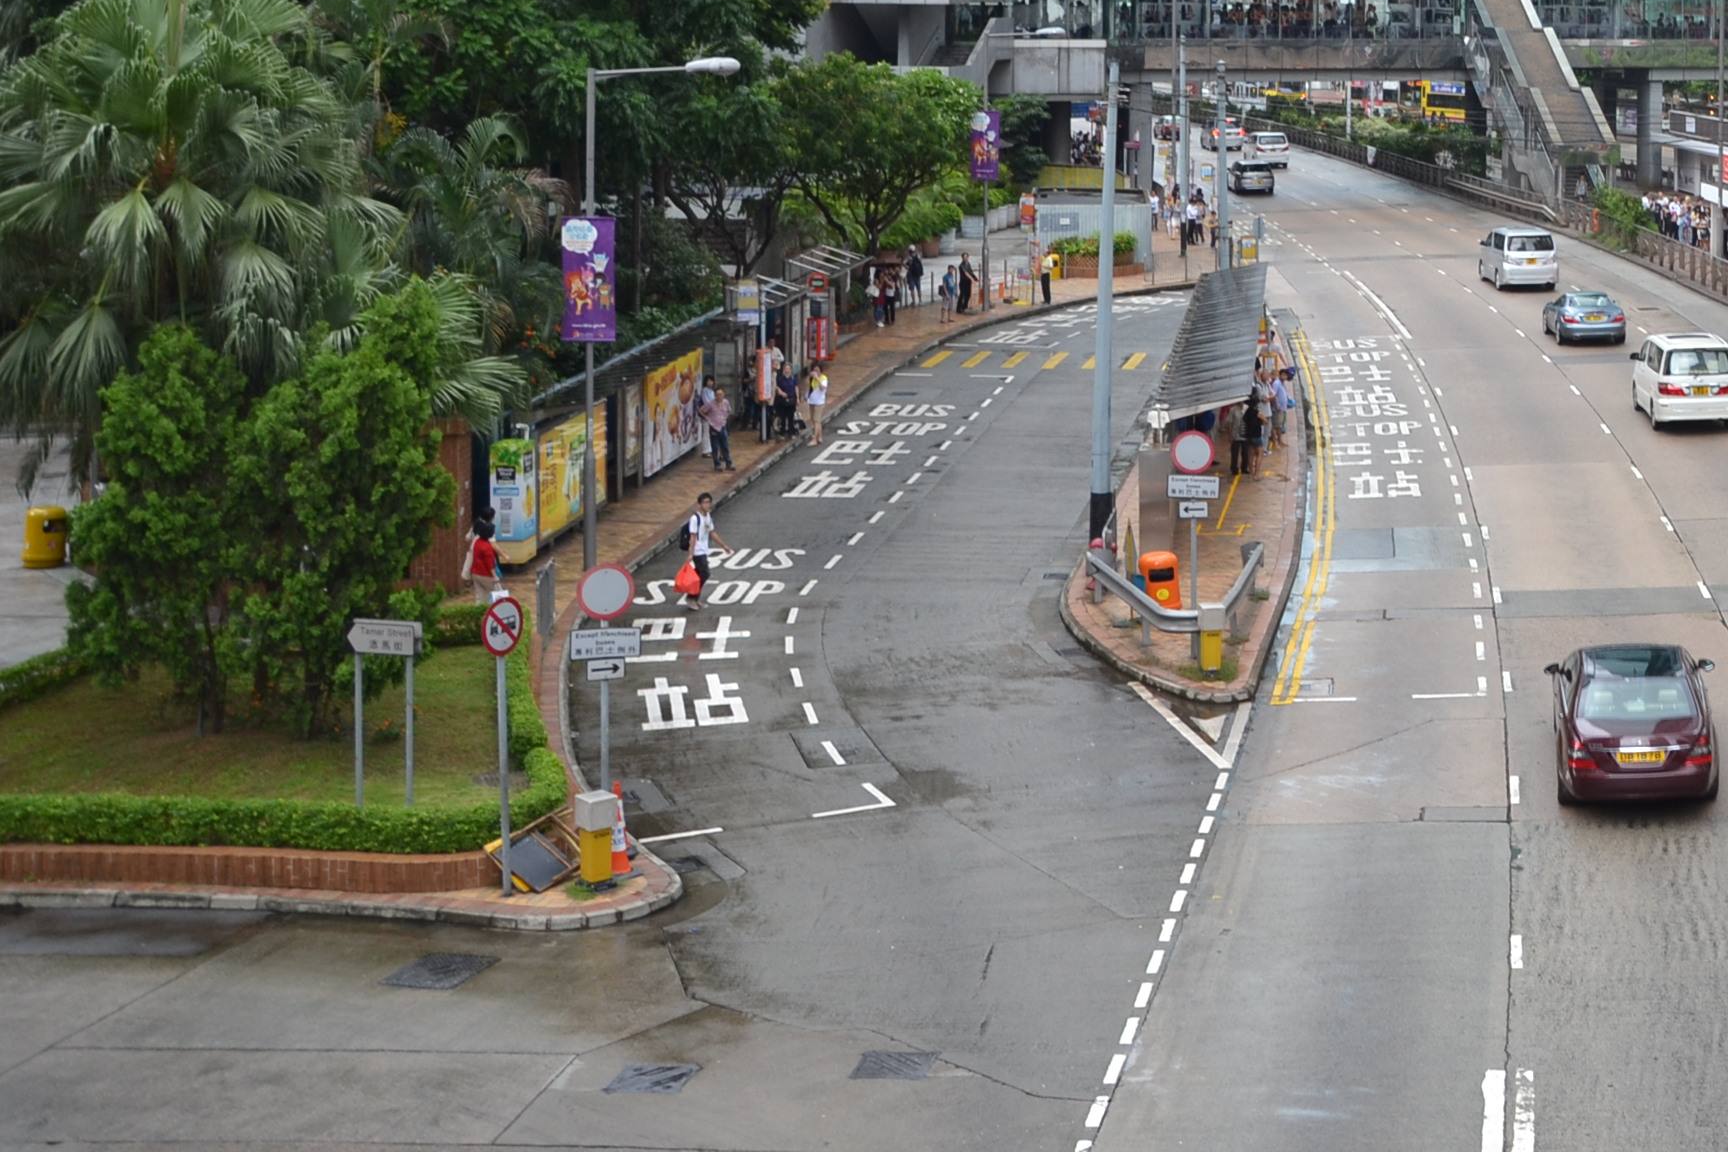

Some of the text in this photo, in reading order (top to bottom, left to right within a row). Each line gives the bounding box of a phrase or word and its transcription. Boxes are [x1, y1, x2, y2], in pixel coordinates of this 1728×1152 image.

[868, 403, 957, 417] BUS
[837, 420, 948, 436] STOP
[811, 440, 912, 465] 巴士
[1332, 440, 1424, 466] 巴士
[781, 470, 874, 499] 站
[1348, 470, 1422, 499] 站
[387, 628, 412, 638] Street
[625, 616, 751, 663] 巴士
[637, 673, 749, 731] 站
